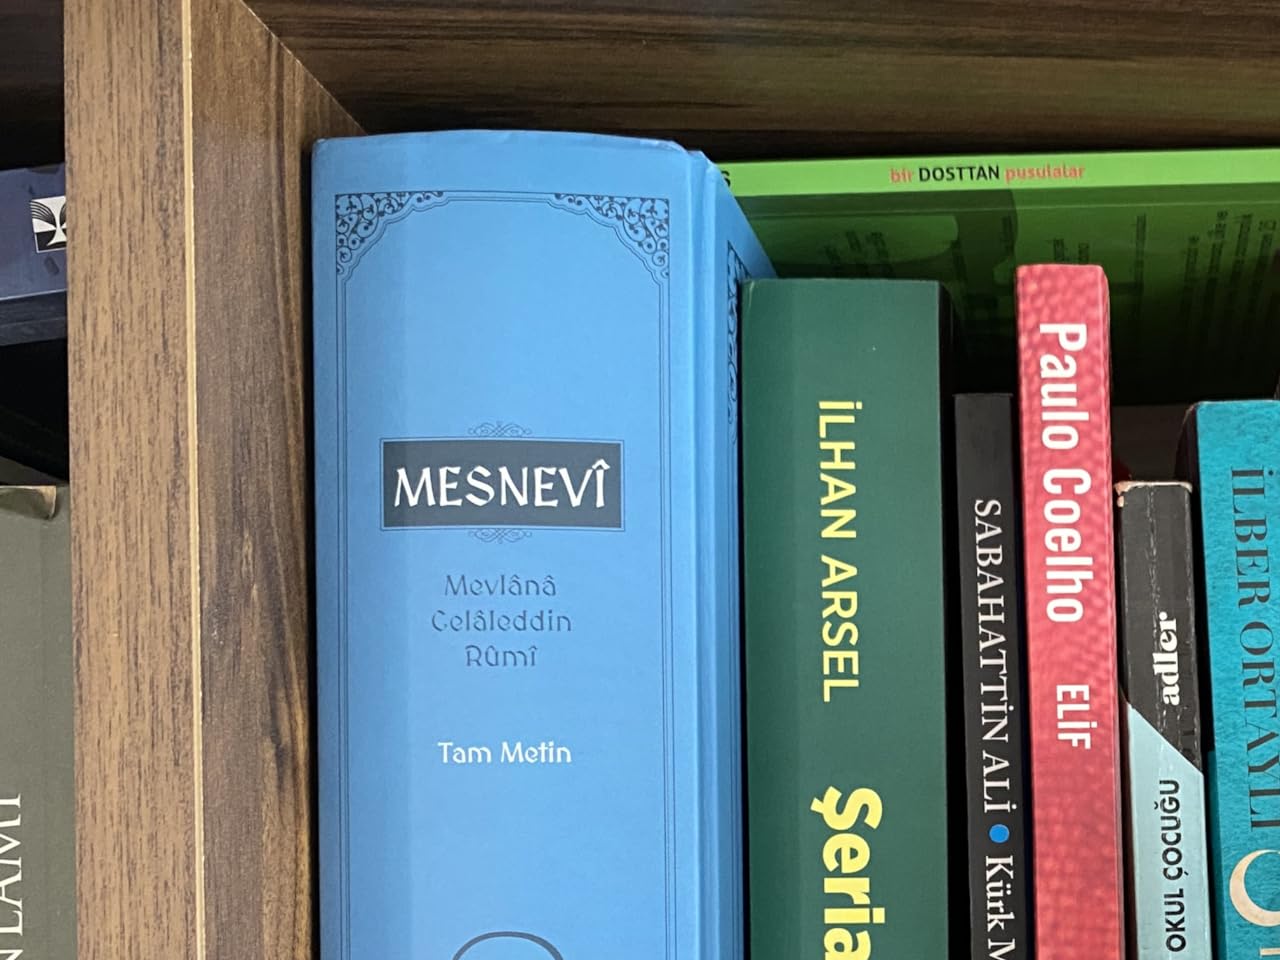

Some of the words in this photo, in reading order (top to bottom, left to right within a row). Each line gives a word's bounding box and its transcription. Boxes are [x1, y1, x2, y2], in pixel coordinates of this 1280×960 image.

[890, 168, 913, 183] bir
[918, 166, 1000, 182] DOSTTAN
[1004, 165, 1086, 188] pusulalar
[1039, 322, 1089, 450] Paulo
[394, 458, 610, 508] MESNEVÎ
[818, 401, 862, 538] İLHAN
[1044, 468, 1094, 623] Coelho
[1230, 466, 1275, 609] İLBER
[430, 609, 573, 632] Celâleddin
[443, 574, 557, 597] Mevlânâ
[973, 499, 1013, 743] SABAHATTİN
[465, 644, 538, 667] Rûmî
[820, 555, 860, 702] ARSEL
[1152, 611, 1180, 706] adler
[1055, 683, 1098, 750] ELİF
[437, 742, 492, 764] Tam
[500, 741, 573, 764] Metin
[981, 749, 1016, 812] ALİ
[1154, 779, 1188, 881] ÇOCUĞU
[985, 855, 1016, 930] Kürk
[1162, 888, 1186, 951] OKUL
